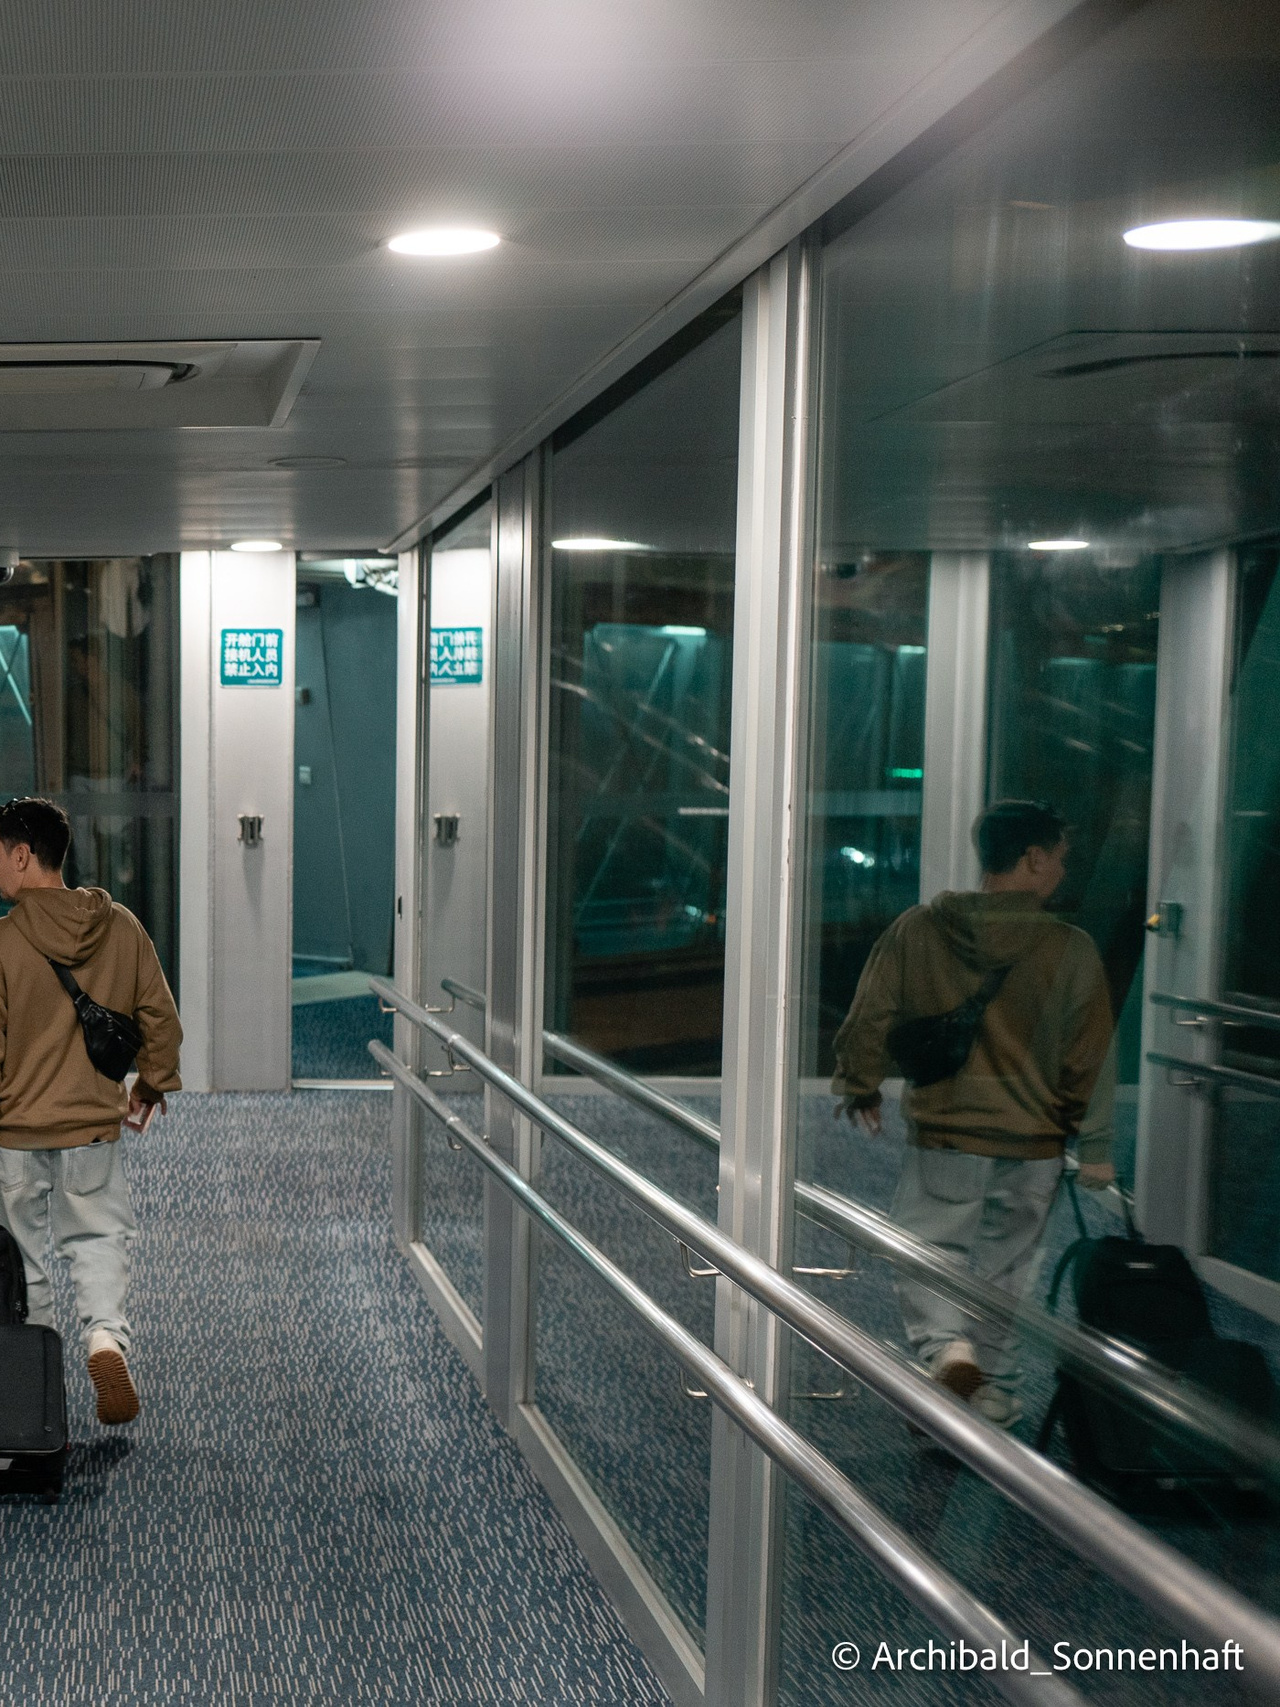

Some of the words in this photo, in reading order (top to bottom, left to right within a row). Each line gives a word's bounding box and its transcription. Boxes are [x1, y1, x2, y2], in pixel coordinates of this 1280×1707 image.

[225, 633, 278, 647] 开舱门前
[225, 648, 277, 662] 接机人员
[225, 662, 277, 676] 禁止入内
